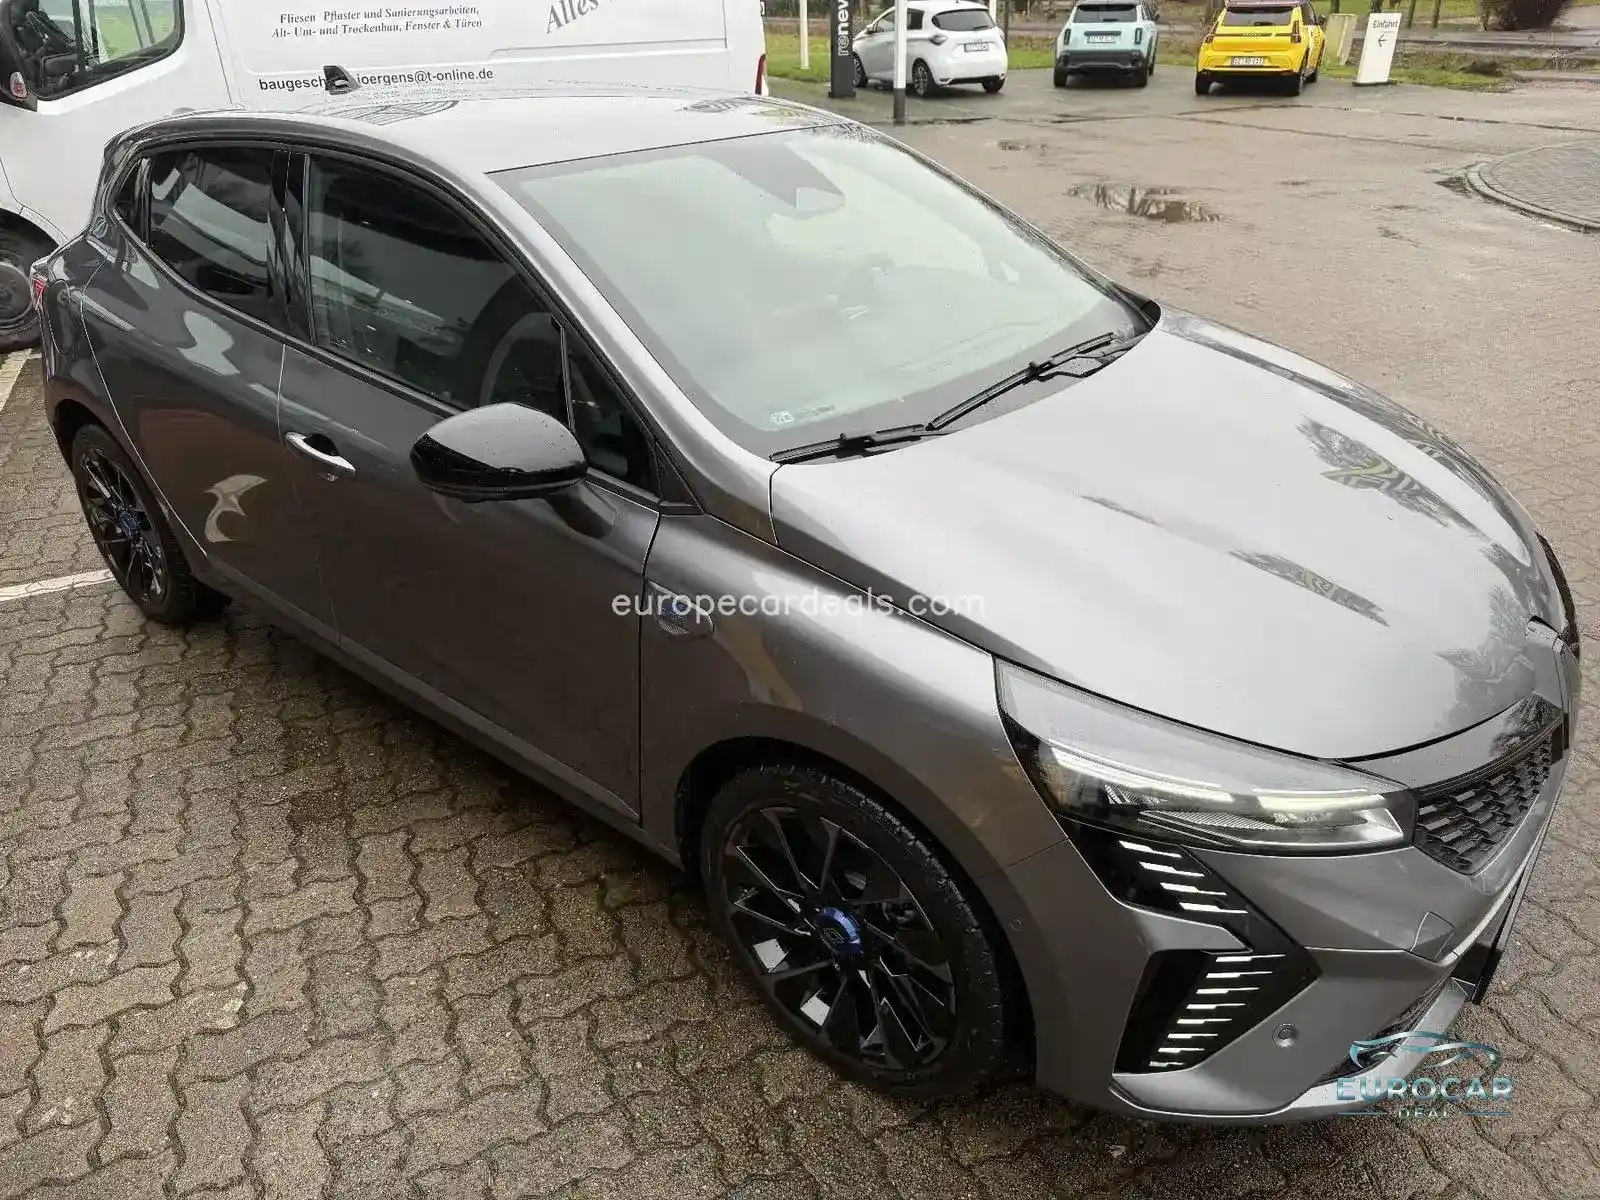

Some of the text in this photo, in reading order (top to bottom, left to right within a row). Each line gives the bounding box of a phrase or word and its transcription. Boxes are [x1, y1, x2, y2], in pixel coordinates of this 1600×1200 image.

[280, 5, 480, 24] Fliesen Pflaster und Sanierungsarbeiten,
[272, 18, 483, 38] Alt- Um- und Trockenbau, Fenster & Türen
[1372, 20, 1399, 29] Einfahrt
